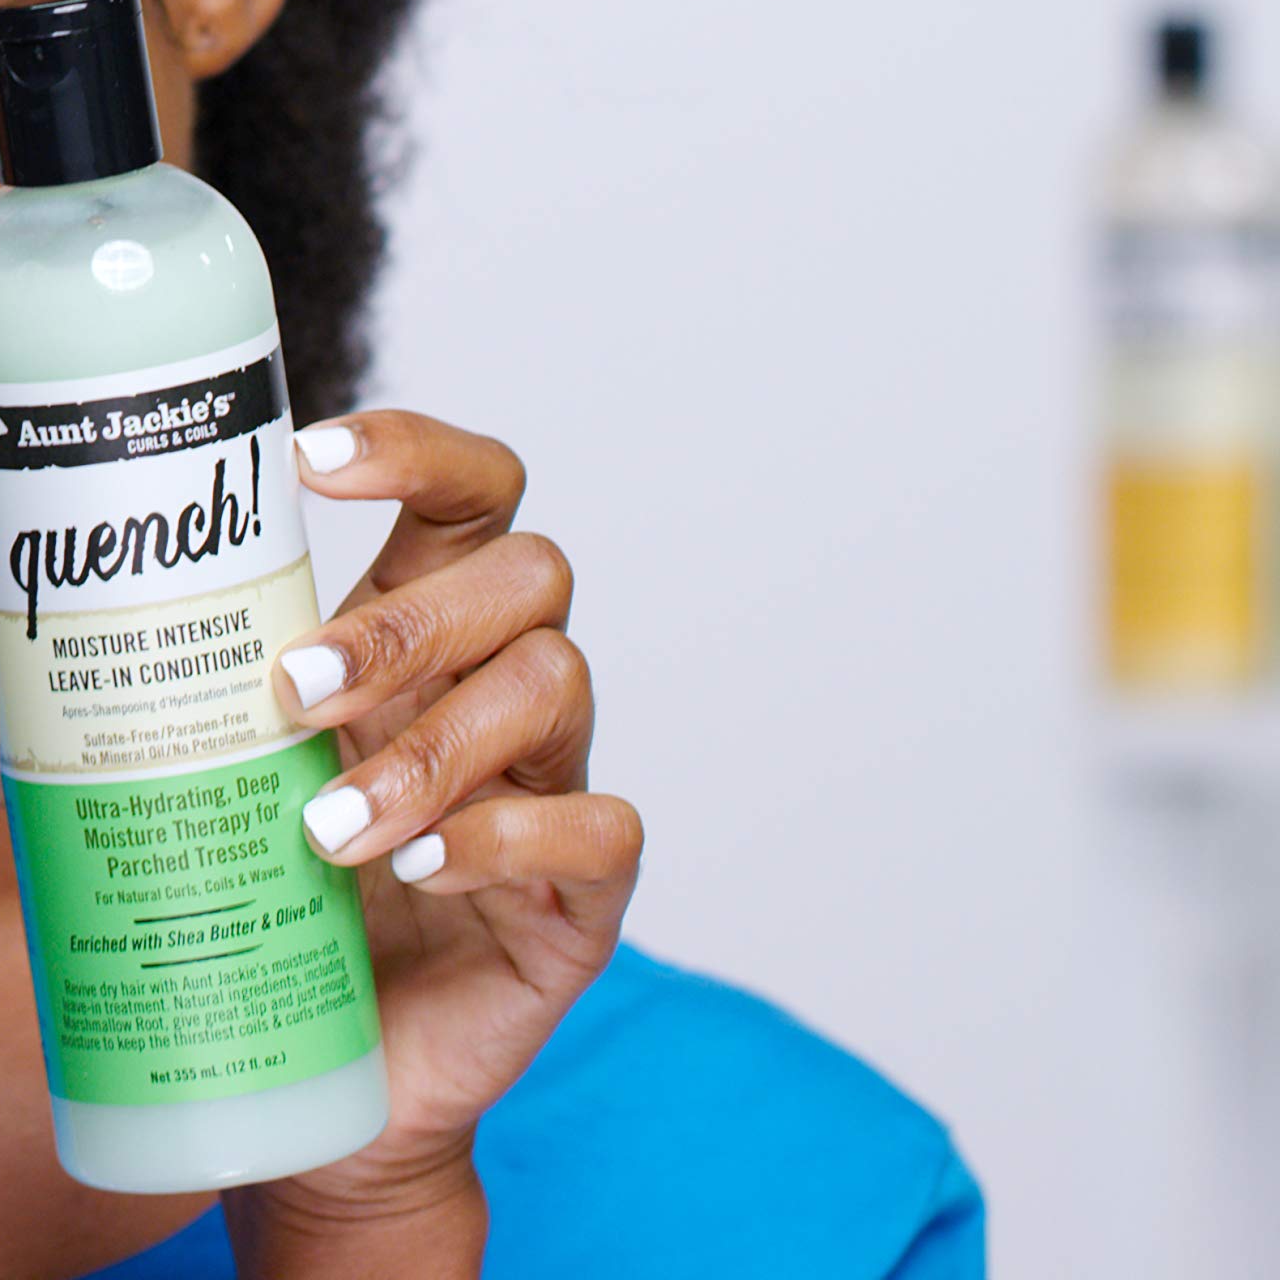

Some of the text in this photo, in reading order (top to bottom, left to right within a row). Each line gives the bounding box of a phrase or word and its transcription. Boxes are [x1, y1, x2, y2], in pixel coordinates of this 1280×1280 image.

[18, 415, 98, 448] Aunt
[127, 422, 218, 455] CURLS & COILS
[10, 435, 263, 642] quench!
[52, 608, 252, 660] MOISTURE INTENSIVE
[49, 639, 264, 692] LEAVE-IN CONDITIONER
[160, 687, 228, 710] d'Hydratation
[231, 677, 263, 695] Intense
[81, 728, 256, 766] No Mineral Oil/No Petrolatum
[84, 711, 249, 748] Sulfate-Free/Paraben-Free
[76, 771, 280, 821] Ultra-Hydrating, Deep
[84, 801, 280, 850] Moisture Therapy for
[107, 837, 269, 879] Parched Tresses
[95, 864, 285, 906] For Natural Curls, Coils & Waves
[70, 895, 323, 953] Enriched with Shea Butter & Olive Oil
[100, 981, 118, 999] dry
[121, 981, 145, 996] hair
[149, 978, 178, 994] with
[183, 973, 213, 991] Aunt
[218, 963, 268, 985] Jackie's
[271, 938, 339, 974] moisture-rich
[173, 1012, 200, 1030] give
[205, 1005, 239, 1028] great
[244, 1001, 267, 1018] slip
[271, 993, 294, 1011] and
[297, 985, 317, 1007] just
[174, 990, 224, 1010] Natural
[103, 1038, 115, 1051] to
[118, 1036, 145, 1053] keep
[149, 1034, 171, 1049] the
[174, 1025, 234, 1047] thirstiest
[240, 1019, 269, 1037] coils
[273, 1013, 282, 1029] &
[285, 1007, 314, 1026] curls
[150, 1070, 171, 1083] Net
[174, 1068, 197, 1081] 355
[226, 1059, 245, 1076] (12
[265, 1050, 287, 1067] oz.)
